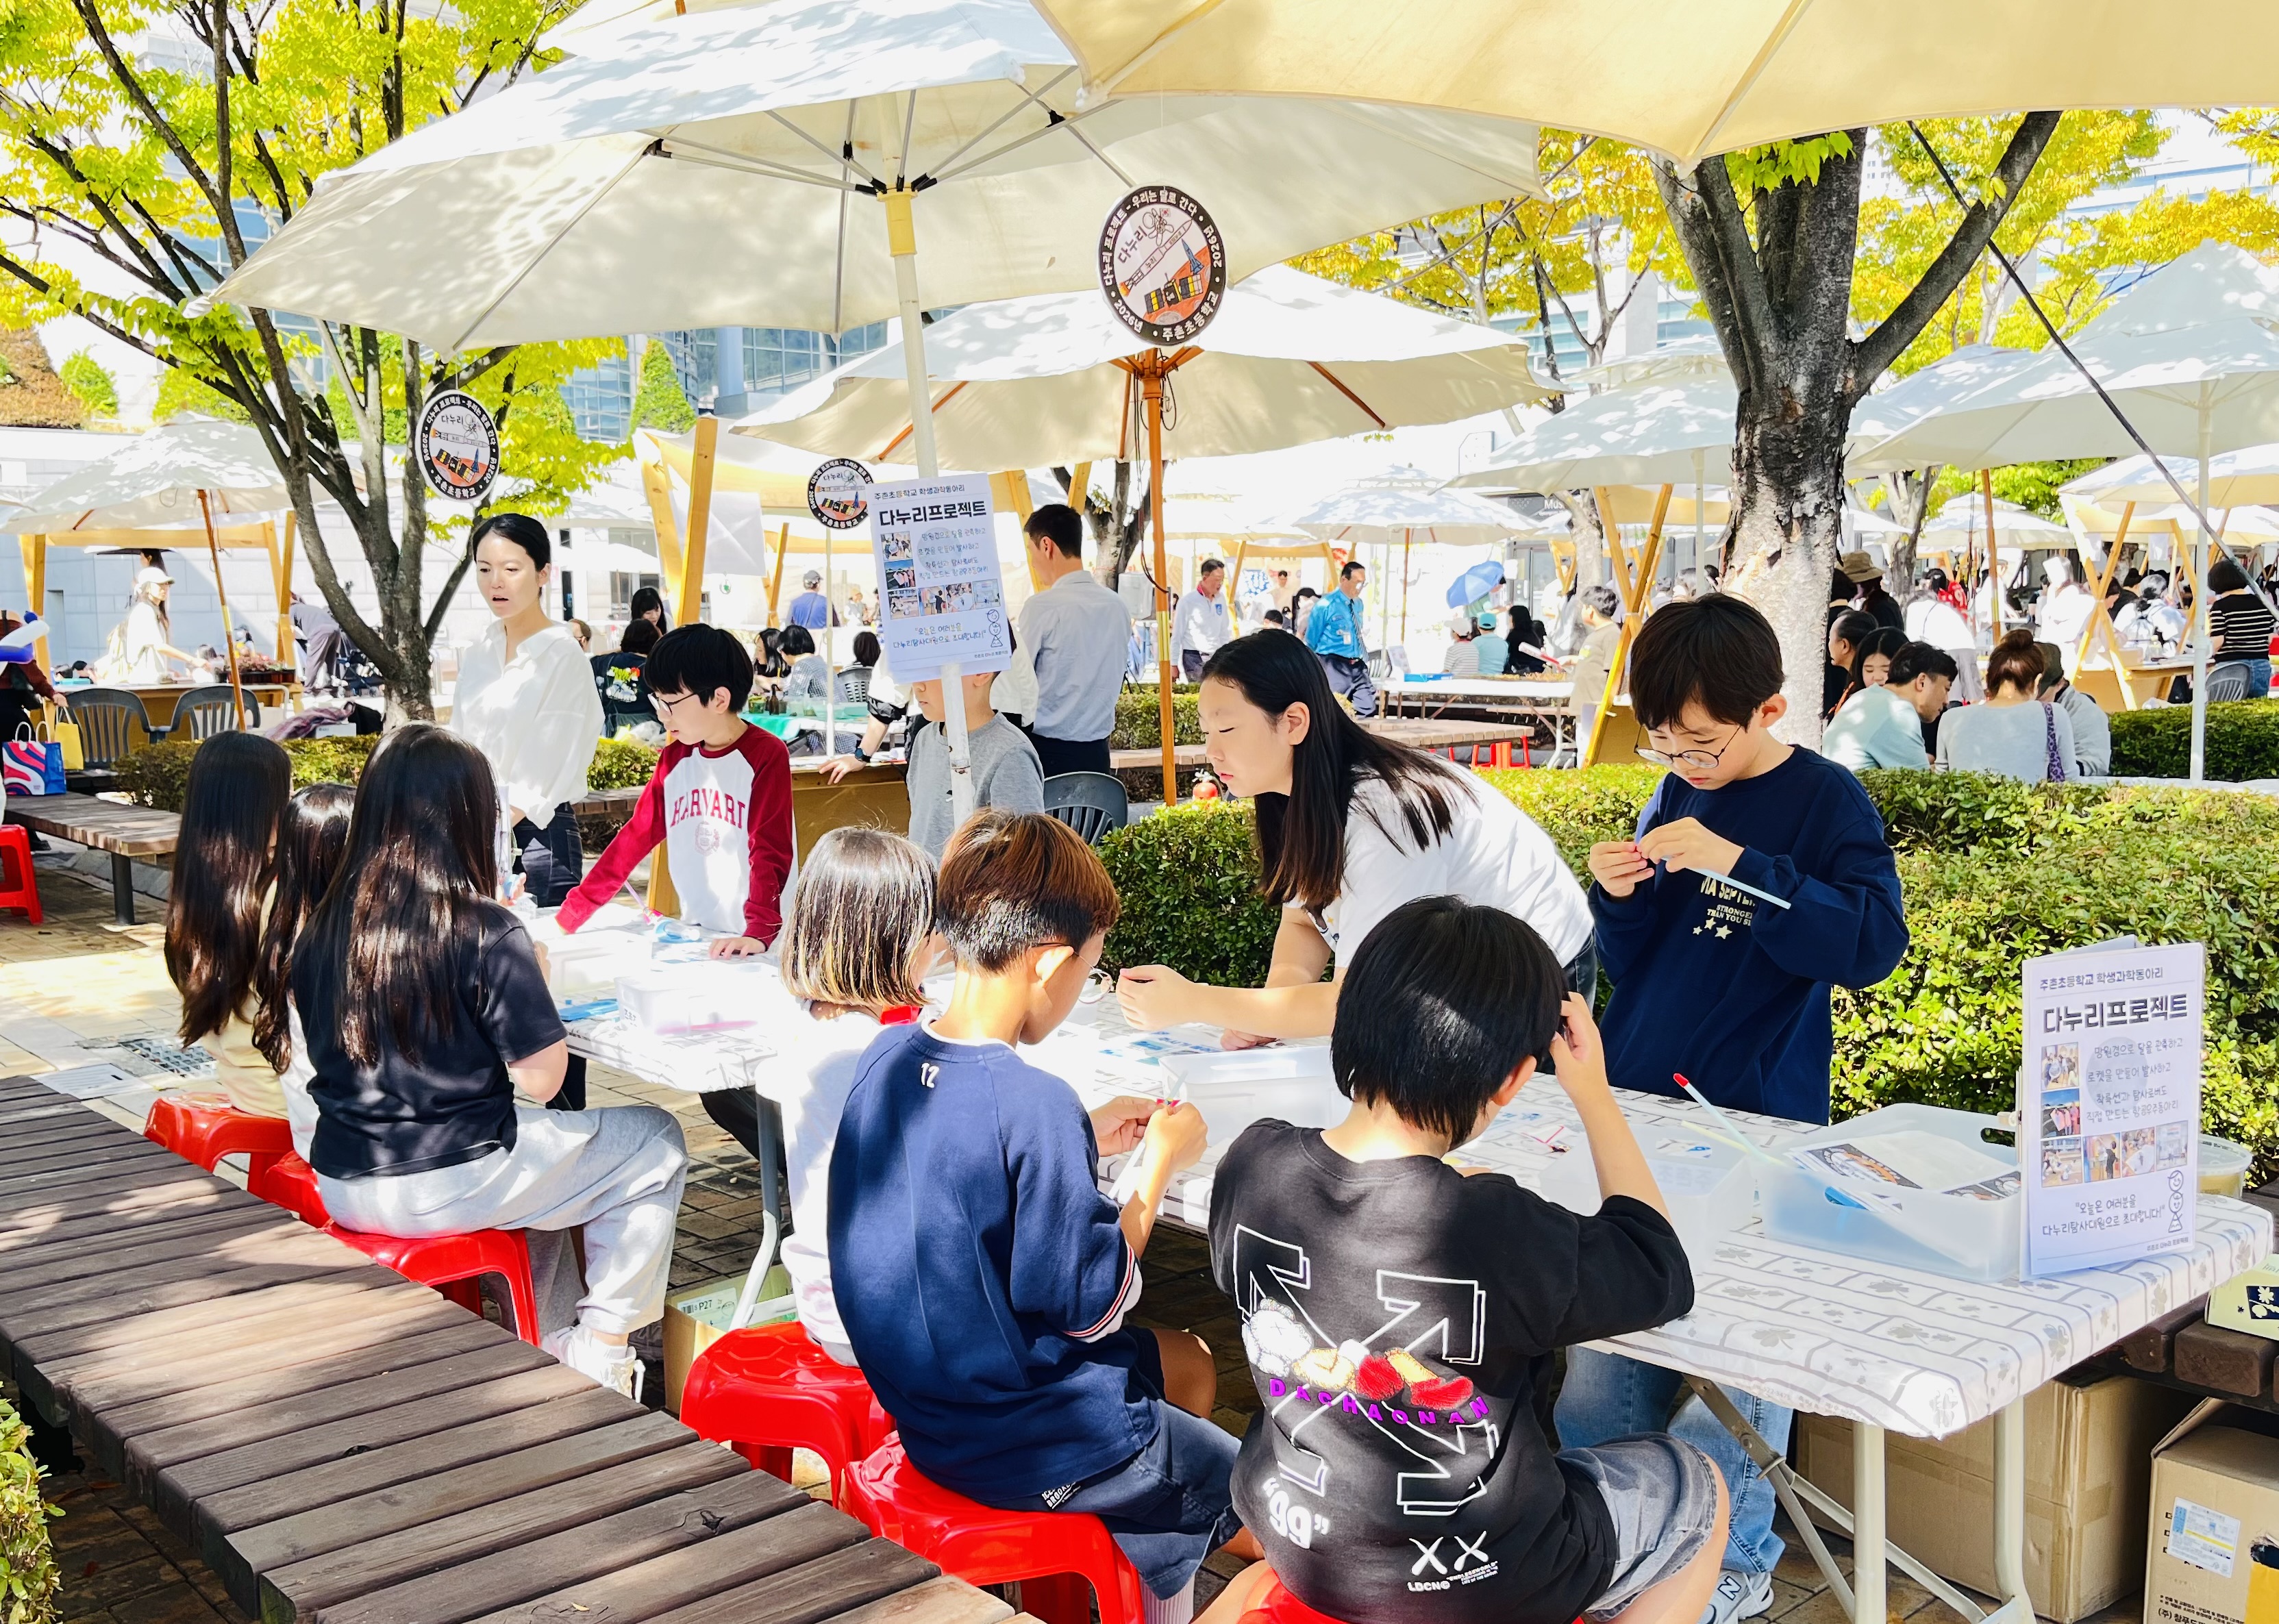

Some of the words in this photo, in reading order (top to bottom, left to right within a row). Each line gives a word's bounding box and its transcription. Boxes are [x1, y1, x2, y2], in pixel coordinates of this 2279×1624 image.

[1132, 190, 1158, 208] 우리는
[1159, 189, 1177, 205] 달로
[1179, 196, 1197, 217] 간다
[1104, 208, 1128, 250] 프로젝트
[1117, 225, 1147, 264] 다누리
[1101, 251, 1114, 286] 다누리
[1113, 299, 1144, 334] 2026년
[1162, 290, 1219, 342] 주촌초등학교
[441, 414, 464, 425] 다누리
[874, 489, 917, 501] 주촌초등학교
[919, 484, 965, 495] 학생과학동아리
[879, 501, 987, 527] 다누리프로젝트
[1726, 913, 1743, 923] YOU
[2039, 973, 2094, 992] 주촌초등학교
[2096, 966, 2164, 984] 학생과학동아리
[2043, 993, 2188, 1034] 다누리프로젝트
[2094, 1044, 2134, 1059] 망원경으로
[921, 1062, 940, 1088] 12
[2087, 1069, 2113, 1083] 로켓을
[2115, 1066, 2140, 1080] 만들어
[2141, 1062, 2171, 1078] 발사하고
[2132, 1085, 2168, 1101] 탐사로버도
[2087, 1111, 2102, 1124] 직접
[2105, 1108, 2130, 1121] 만드는
[2132, 1099, 2179, 1119] 항공우주동아리
[2106, 1194, 2137, 1210] 여러분을
[2042, 1215, 2121, 1236] 다누리탐사대원으로
[699, 1299, 712, 1310] P27
[1717, 1575, 1742, 1601] N
